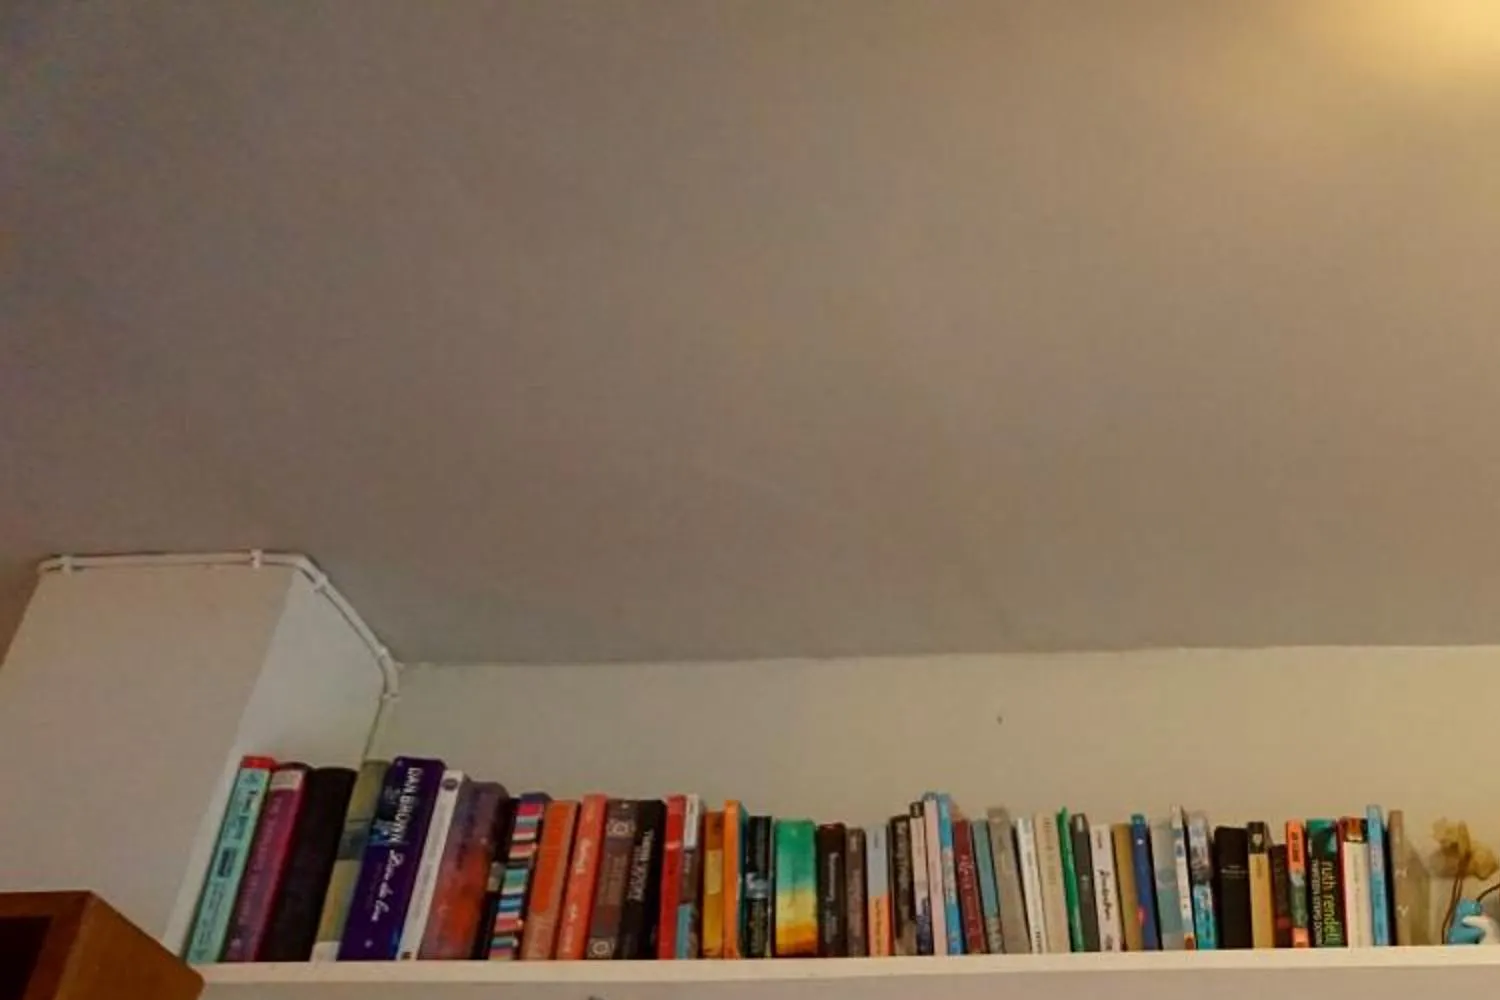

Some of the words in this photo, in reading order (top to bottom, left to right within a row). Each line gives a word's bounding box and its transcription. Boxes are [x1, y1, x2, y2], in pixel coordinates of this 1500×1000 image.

[404, 767, 423, 793] DAN
[390, 794, 415, 842] BROWN
[1321, 861, 1336, 890] ruth
[1323, 893, 1342, 946] rendell
